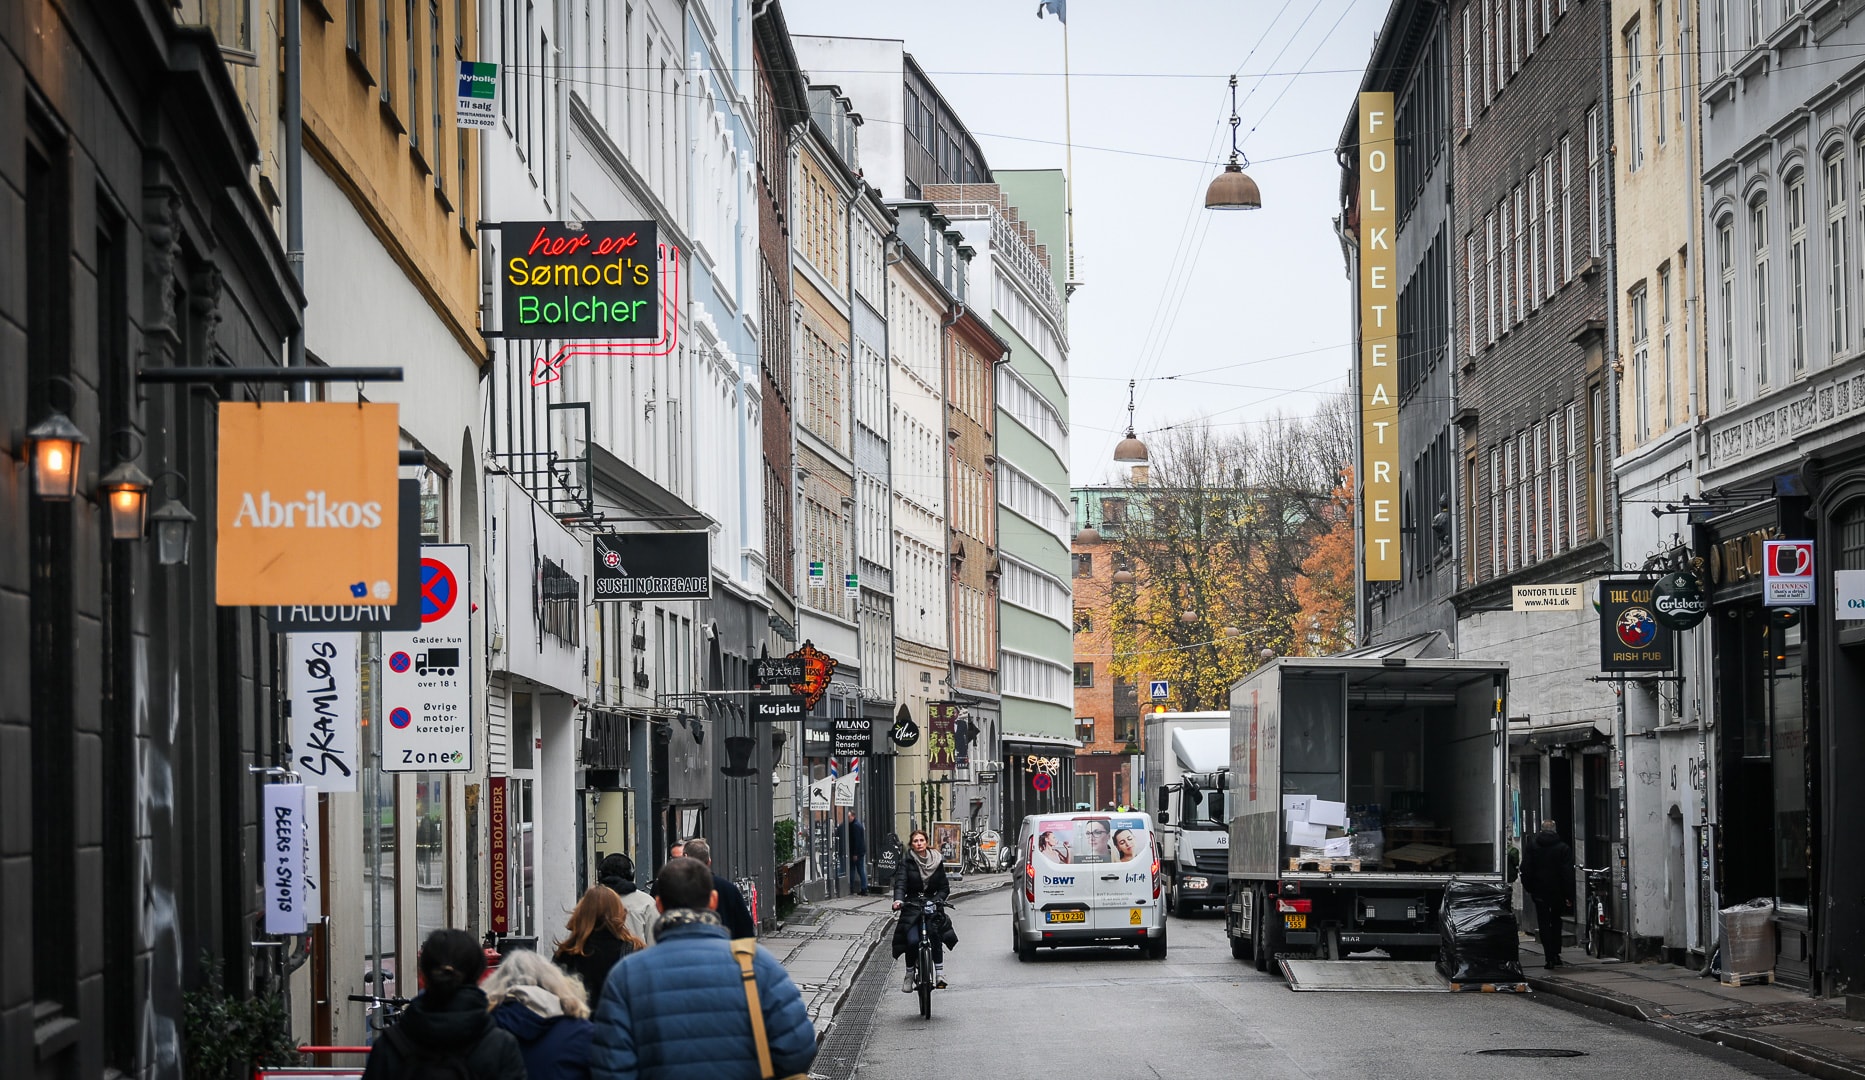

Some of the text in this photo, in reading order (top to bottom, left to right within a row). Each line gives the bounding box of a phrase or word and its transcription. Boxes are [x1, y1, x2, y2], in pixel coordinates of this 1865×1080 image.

[459, 74, 496, 84] Nybolig
[460, 100, 492, 111] Til salg
[528, 227, 638, 256] her er
[508, 257, 649, 286] Sømod's
[519, 295, 648, 324] Bolcher
[1368, 110, 1393, 562] FOLKETEATRET
[233, 490, 382, 528] Abrikos
[596, 575, 708, 595] SUSHI NØRREGADE
[1517, 587, 1577, 597] KONTOR TIL LEJE
[1610, 590, 1652, 603] THE GLO
[1525, 598, 1570, 606] www.N41.dk
[1655, 595, 1706, 613] Carlsberg
[1613, 652, 1661, 661] IRISH PUB
[299, 641, 352, 777] SKAMLØS
[423, 703, 458, 712] Øvrige
[760, 704, 800, 715] Kujaku
[423, 714, 458, 722] motor-
[416, 725, 465, 734] køretøjer
[835, 720, 870, 729] MILANO
[402, 750, 450, 764] Zone
[274, 806, 292, 852] BEERS
[1216, 837, 1227, 845] AB
[493, 786, 505, 909] SØMODS BOLCHER
[1053, 876, 1075, 885] BWT
[276, 866, 293, 913] SHOTS
[1050, 911, 1084, 921] DT 19 230
